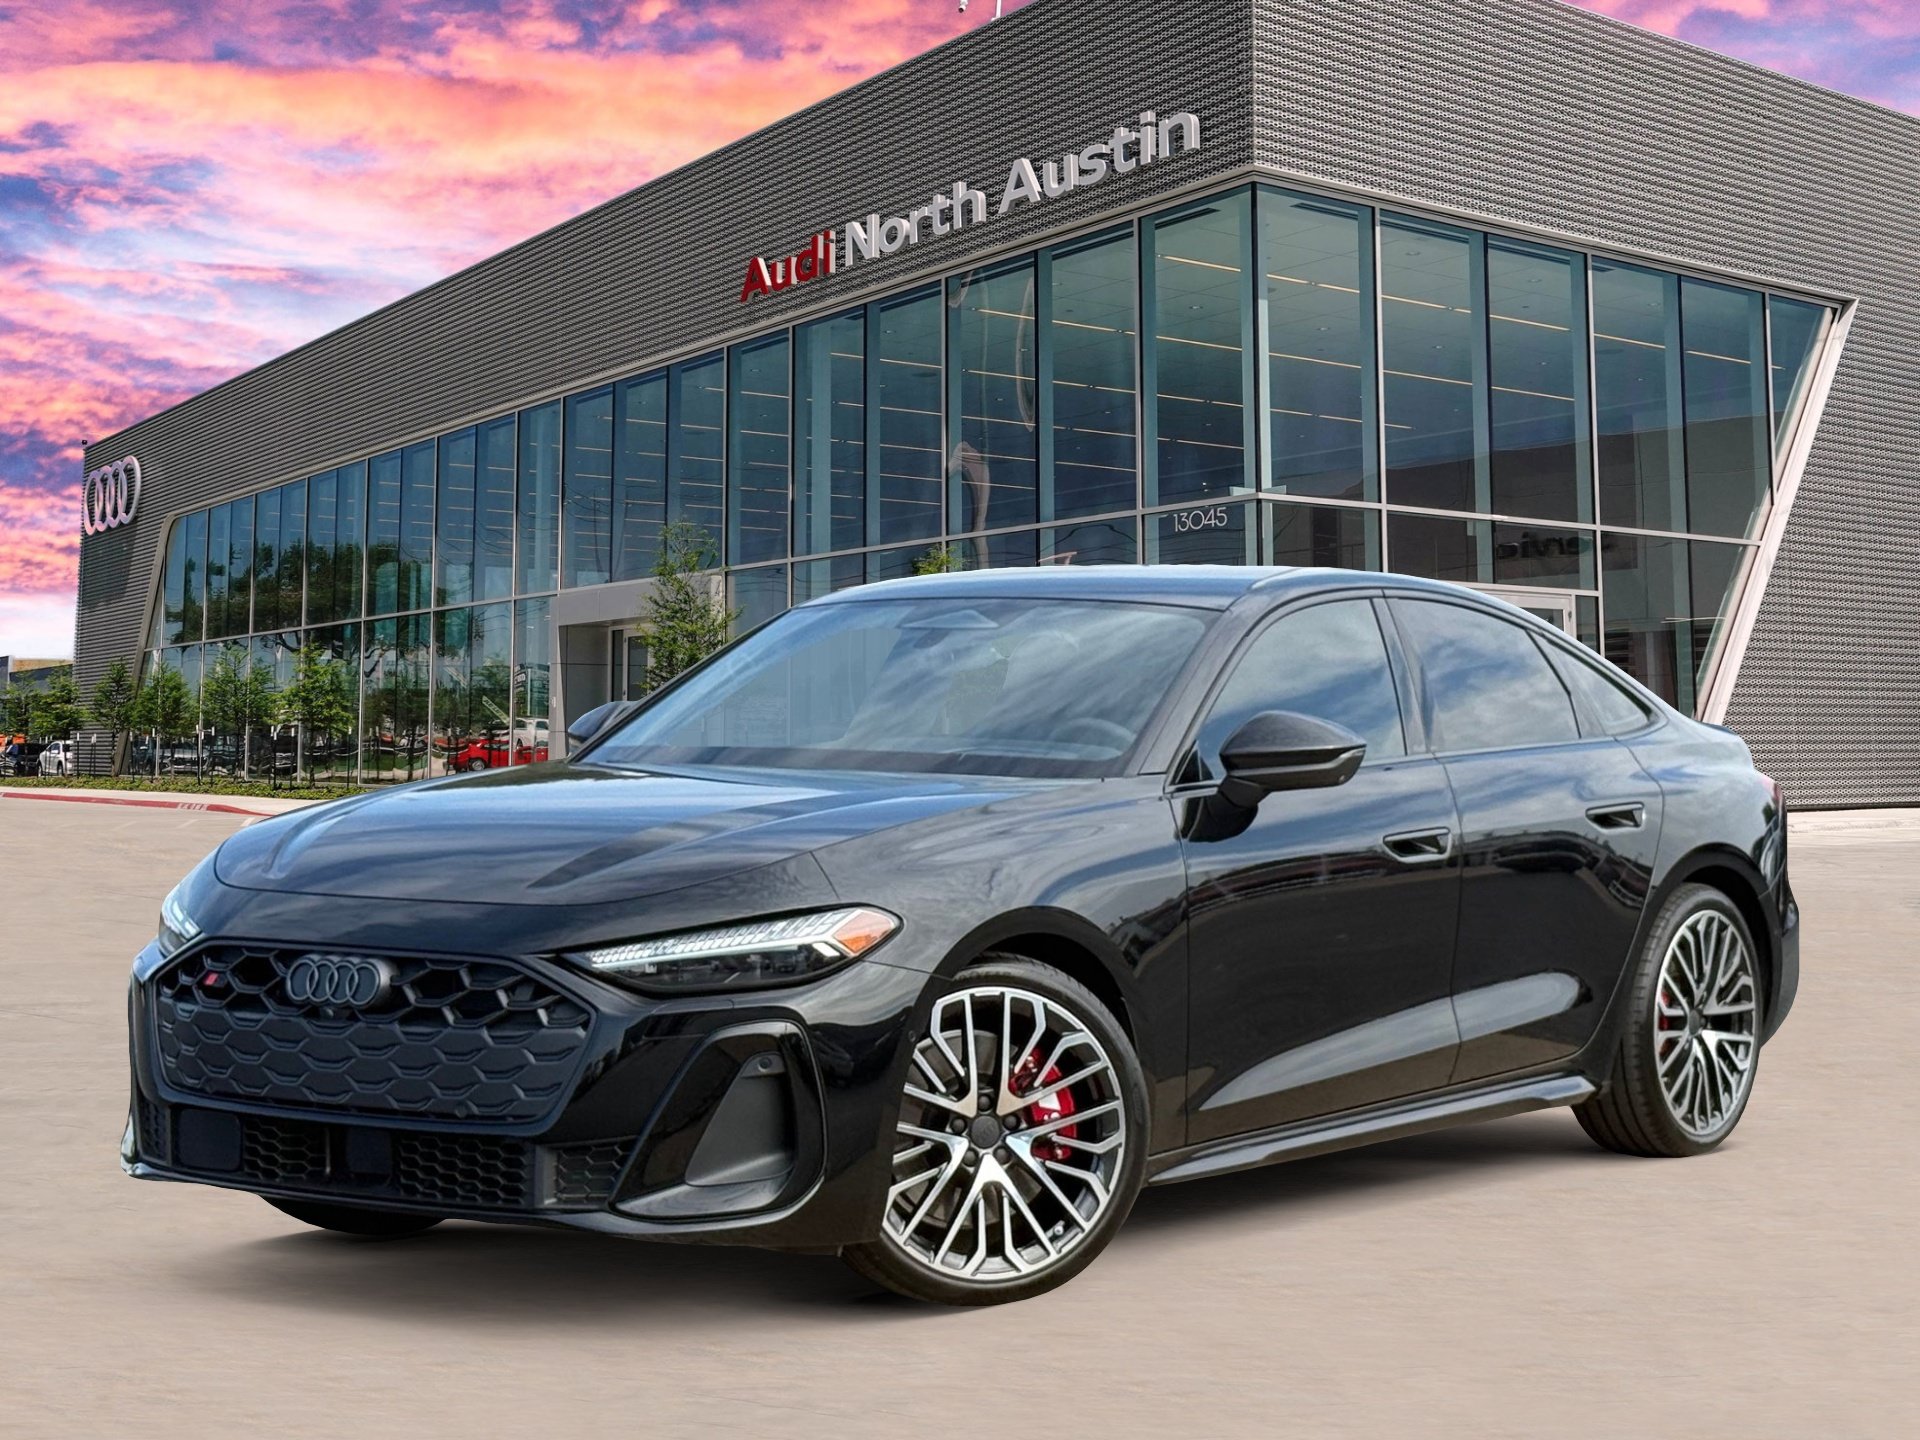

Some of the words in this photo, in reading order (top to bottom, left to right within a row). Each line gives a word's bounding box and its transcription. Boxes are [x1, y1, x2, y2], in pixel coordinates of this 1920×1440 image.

[741, 230, 836, 303] Audi
[845, 181, 986, 267] North
[999, 110, 1201, 213] Austin
[1173, 506, 1228, 532] 13045
